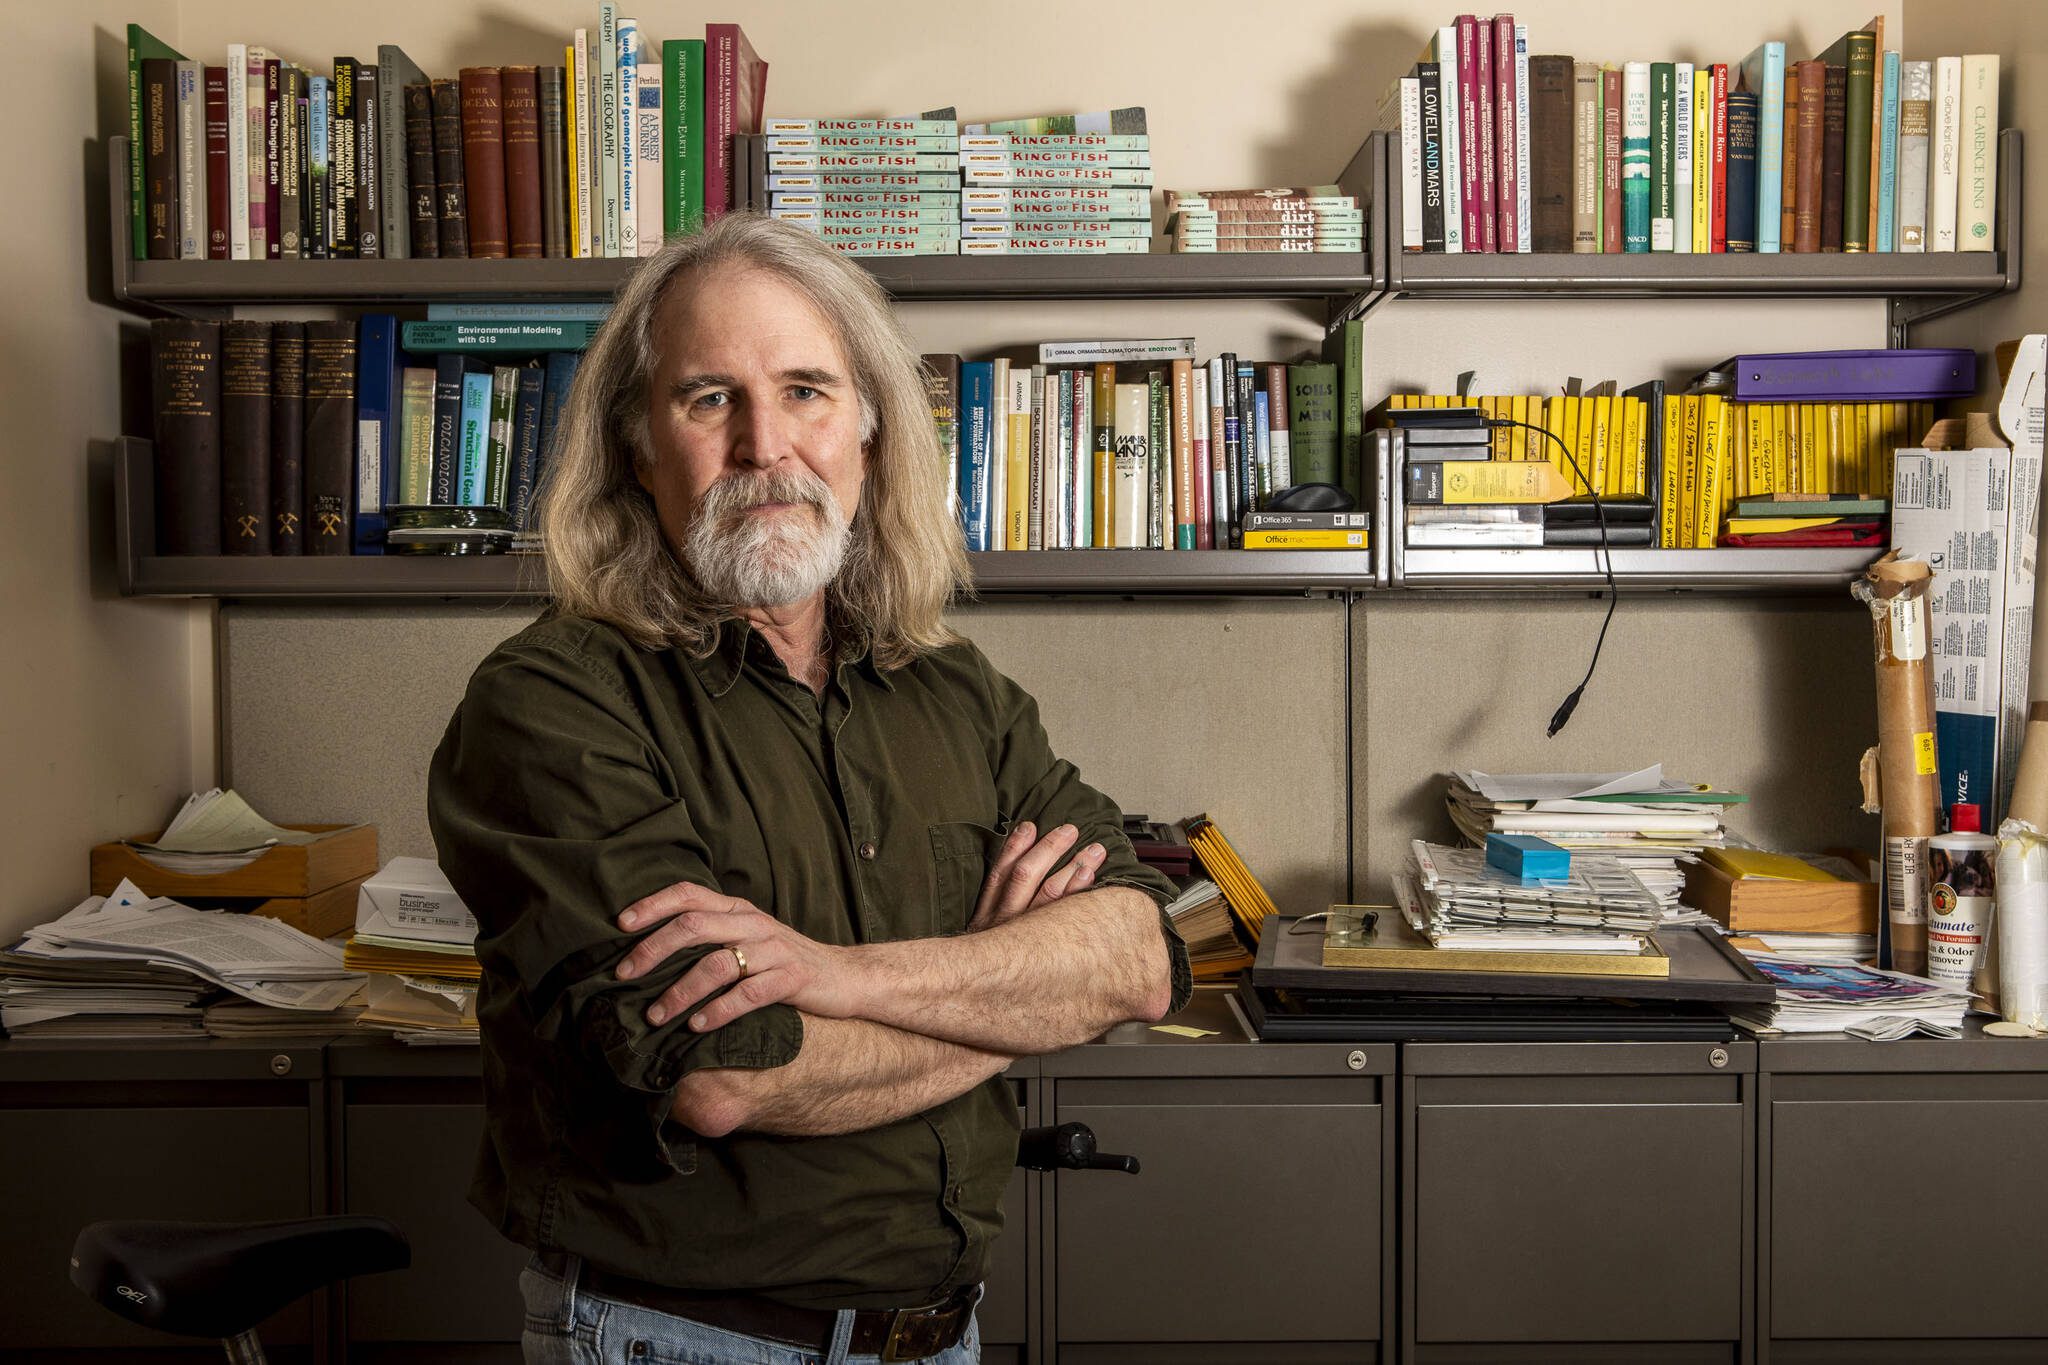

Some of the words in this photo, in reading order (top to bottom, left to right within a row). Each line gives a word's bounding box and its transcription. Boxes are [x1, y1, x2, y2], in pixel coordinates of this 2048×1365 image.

[604, 6, 612, 42] PTOLEMY
[622, 38, 632, 67] world
[313, 83, 322, 97] the
[344, 77, 352, 97] COOKE
[604, 72, 614, 92] THE
[622, 69, 632, 94] atlas
[678, 50, 688, 112] DEFORESTING
[724, 76, 731, 87] AS
[1717, 68, 1726, 98] Salmon
[270, 100, 278, 116] The
[313, 99, 322, 116] soil
[383, 90, 393, 128] Population
[622, 96, 632, 106] of
[1678, 96, 1688, 122] WORLD
[1888, 98, 1896, 114] The
[1943, 95, 1953, 124] Grove
[282, 94, 290, 148] ENVIRONMENTAL
[313, 116, 322, 132] will
[366, 99, 374, 154] GEOMORPHOLOGY
[604, 94, 614, 158] GEOGRAPHY
[818, 120, 858, 130] KING
[876, 120, 915, 130] FISH
[1518, 115, 1526, 132] FOR
[1678, 122, 1688, 132] OF
[1717, 100, 1726, 134] Without
[269, 118, 279, 160] Changing
[313, 133, 322, 149] save
[621, 108, 633, 169] geomorphic
[640, 113, 649, 161] JOURNEY
[650, 121, 659, 162] FOREST
[678, 125, 688, 158] EARTH
[820, 136, 860, 146] KING
[879, 136, 916, 146] FISH
[1011, 136, 1050, 146] KING
[1068, 136, 1106, 146] FISH
[1886, 116, 1895, 170] Mediterranean
[1943, 125, 1953, 142] Karl
[1974, 106, 1986, 173] CLARENCE
[290, 127, 298, 188] GEOMORPHOLOGY
[313, 150, 322, 162] us
[336, 120, 346, 184] ENVIRONMENTAL
[345, 119, 354, 188] GEOMORPHOLOGY
[1424, 87, 1440, 206] LOWELLANDMARS
[1678, 134, 1688, 160] RIVERS
[1717, 136, 1726, 163] Rivers
[1943, 144, 1953, 175] Gilbert
[270, 161, 279, 185] Earth
[282, 149, 290, 196] MANAGEMENT
[1016, 168, 1055, 178] KING
[1074, 168, 1112, 178] FISH
[1520, 164, 1528, 192] EARTH
[1882, 172, 1893, 198] Valleys
[346, 188, 354, 198] IN
[623, 170, 633, 211] features
[825, 193, 864, 203] KING
[883, 194, 921, 203] FISH
[1974, 176, 1986, 208] KING
[336, 186, 346, 241] MANAGEMENT
[1280, 210, 1314, 222] dirt
[1280, 224, 1314, 237] dirt
[1280, 238, 1314, 251] dirt
[458, 326, 520, 334] Environmental
[522, 327, 562, 336] Modeling
[458, 336, 477, 344] with
[479, 336, 496, 344] GIS
[1296, 384, 1332, 396] SOILS
[1032, 407, 1041, 428] SOIL
[438, 414, 452, 503] VOLCANOLOGY
[464, 420, 476, 476] Structural
[1115, 445, 1147, 458] LAND
[1032, 429, 1041, 511] GEOMORPHOLOGY
[1262, 516, 1280, 524] Office
[1281, 516, 1292, 524] 365
[1266, 535, 1288, 544] Office
[1904, 838, 1914, 848] XH
[399, 898, 440, 910] business
[1948, 947, 1974, 956] Odor
